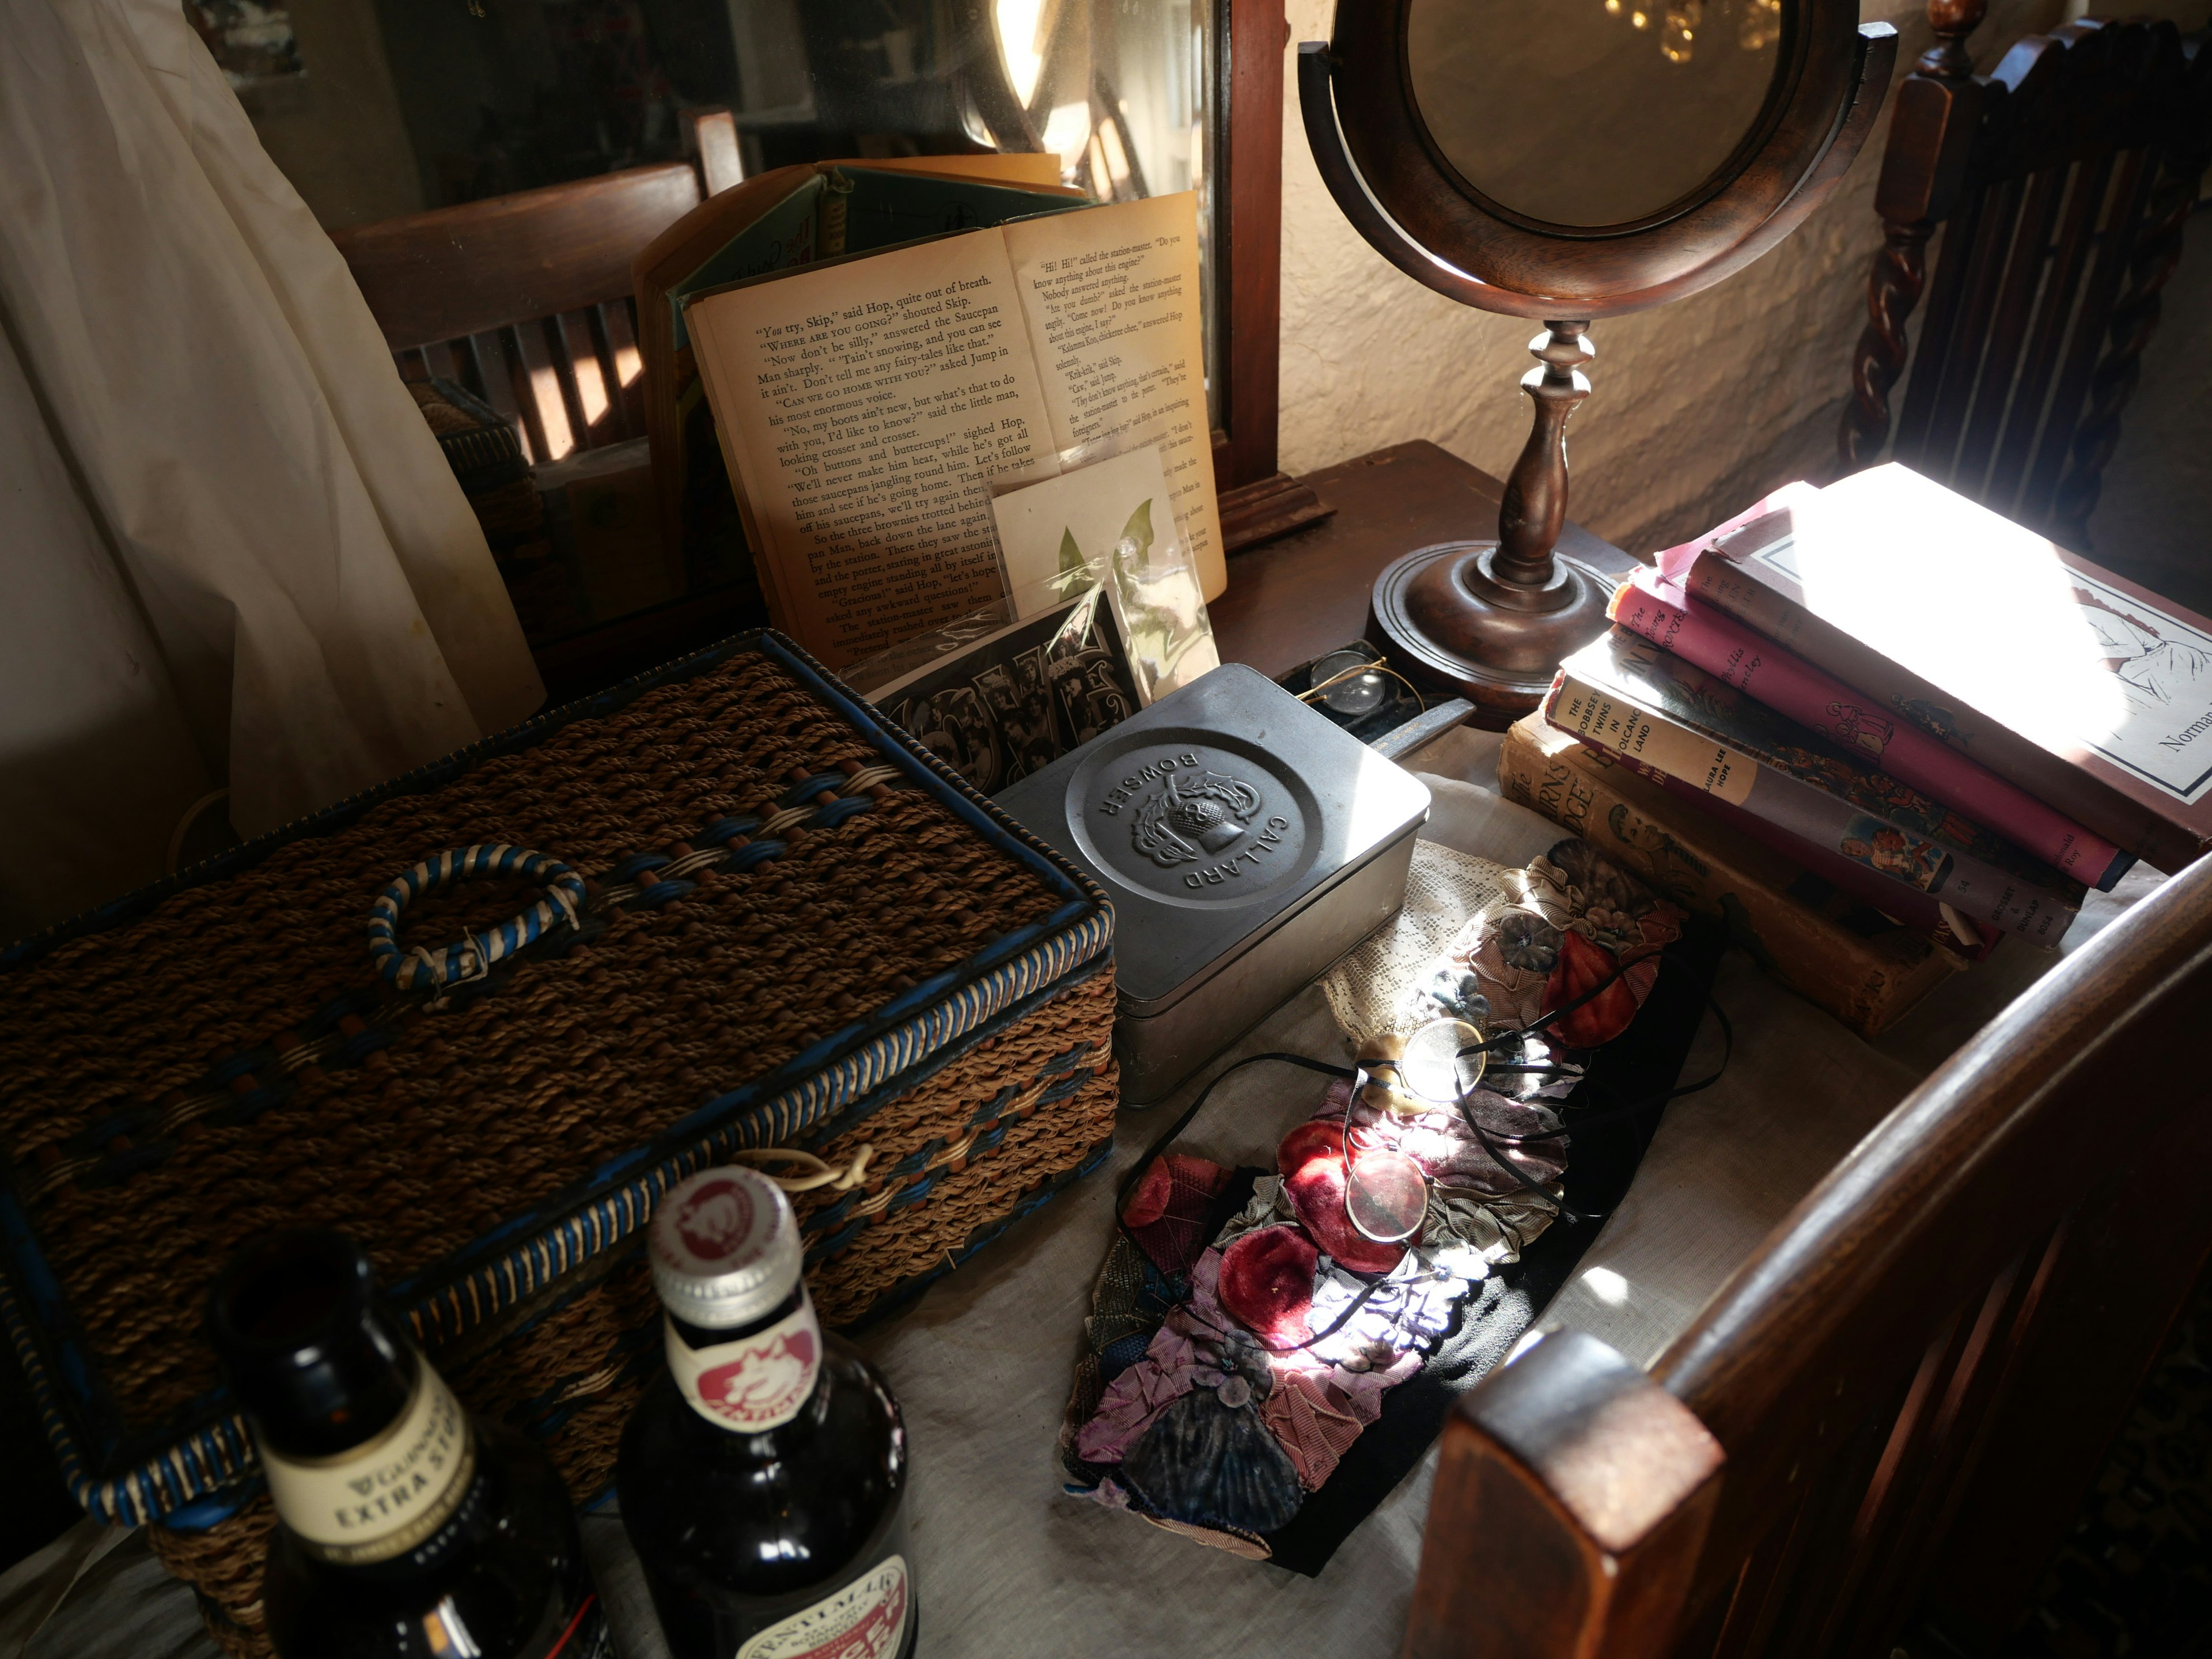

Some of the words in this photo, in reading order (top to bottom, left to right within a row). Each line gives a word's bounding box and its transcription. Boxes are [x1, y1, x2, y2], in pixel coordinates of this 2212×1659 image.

[755, 326, 782, 338] “You
[785, 323, 804, 335] try,
[806, 311, 838, 328] Skip,”
[842, 305, 863, 320] said
[865, 302, 893, 314] Hop,
[896, 293, 922, 309] quite
[925, 288, 942, 299] out
[945, 281, 956, 294] of
[958, 275, 991, 291] breath.
[760, 337, 806, 351] “WHERE
[809, 331, 828, 343] ARE
[830, 326, 851, 337] YOU
[854, 312, 898, 331] GOING?”
[903, 301, 943, 320] shouted
[945, 298, 971, 309] Skip.
[764, 355, 796, 366] “Now
[801, 345, 828, 359] don’t
[831, 342, 844, 353] be
[849, 332, 877, 349] silly,”
[883, 319, 931, 340] answered
[934, 316, 950, 327] the
[955, 305, 998, 322] Saucepan
[760, 388, 770, 399] it
[772, 383, 797, 396] ain’t.
[802, 374, 834, 389] Don’t
[835, 368, 853, 381] tell
[855, 367, 871, 377] me
[873, 362, 891, 373] any
[894, 349, 943, 368] fairy-tales
[945, 343, 964, 355] like
[967, 333, 994, 349] that.”
[768, 414, 784, 426] his
[786, 410, 811, 422] most
[813, 399, 863, 416] enormous
[865, 391, 896, 403] voice.
[776, 440, 800, 453] with
[802, 438, 825, 450] you,
[827, 429, 843, 442] I’d
[845, 426, 865, 438] like
[868, 425, 879, 433] to
[882, 411, 922, 429] know?”
[927, 404, 948, 419] said
[950, 402, 967, 412] the
[969, 395, 993, 408] little
[995, 391, 1018, 402] man,
[779, 452, 819, 467] looking
[822, 444, 856, 457] crosser
[859, 435, 878, 449] and
[881, 430, 919, 444] crosser.
[794, 465, 819, 476] “Oh
[823, 457, 862, 472] buttons
[868, 448, 887, 461] and
[963, 422, 995, 440] sighed
[1000, 418, 1025, 429] Hop.
[791, 495, 819, 507] those
[820, 484, 869, 501] saucepans
[870, 474, 912, 493] jangling
[914, 463, 945, 479] round
[946, 460, 969, 472] him.
[974, 451, 999, 465] Let’s
[1001, 444, 1031, 458] follow
[825, 608, 853, 624] asked
[855, 607, 872, 618] any
[876, 593, 921, 612] awkward
[923, 581, 978, 604] questions!”
[1662, 608, 1688, 649] RONTES
[1569, 698, 1582, 717] THE
[1578, 690, 1601, 736] BOBBSEY
[1592, 703, 1612, 735] TWINS
[1611, 720, 1621, 733] IN
[1634, 724, 1650, 753] LAND
[1098, 752, 1199, 817] BOWSER
[1703, 766, 1719, 793] LAURA
[1715, 748, 1726, 763] LEE
[1717, 764, 1731, 787] HOPE
[1183, 816, 1290, 891] CALLARD
[2065, 849, 2082, 866] Roy
[1957, 880, 1970, 893] 54
[1992, 886, 2016, 922] GROSSET
[2017, 900, 2040, 933] DUNLAP
